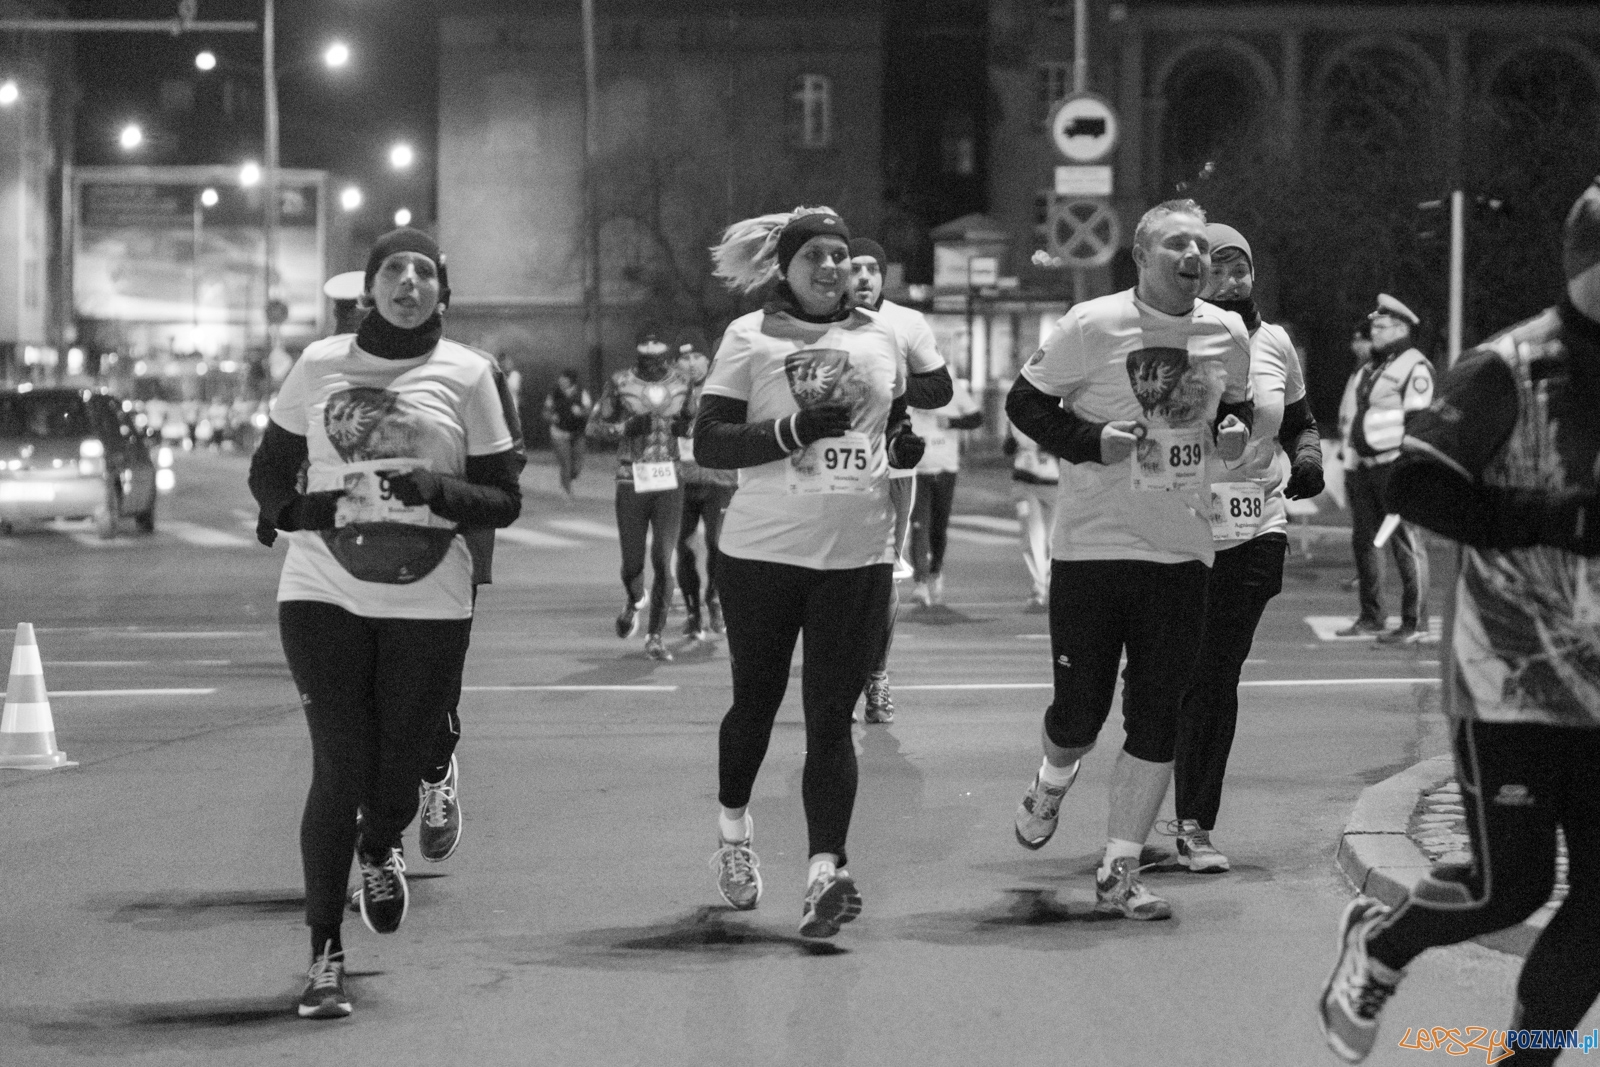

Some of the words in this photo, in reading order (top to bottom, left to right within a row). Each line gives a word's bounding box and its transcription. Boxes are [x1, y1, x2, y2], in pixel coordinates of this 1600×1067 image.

[824, 447, 867, 470] 975
[1169, 443, 1202, 468] 839
[651, 466, 672, 478] 265
[1229, 497, 1262, 518] 838
